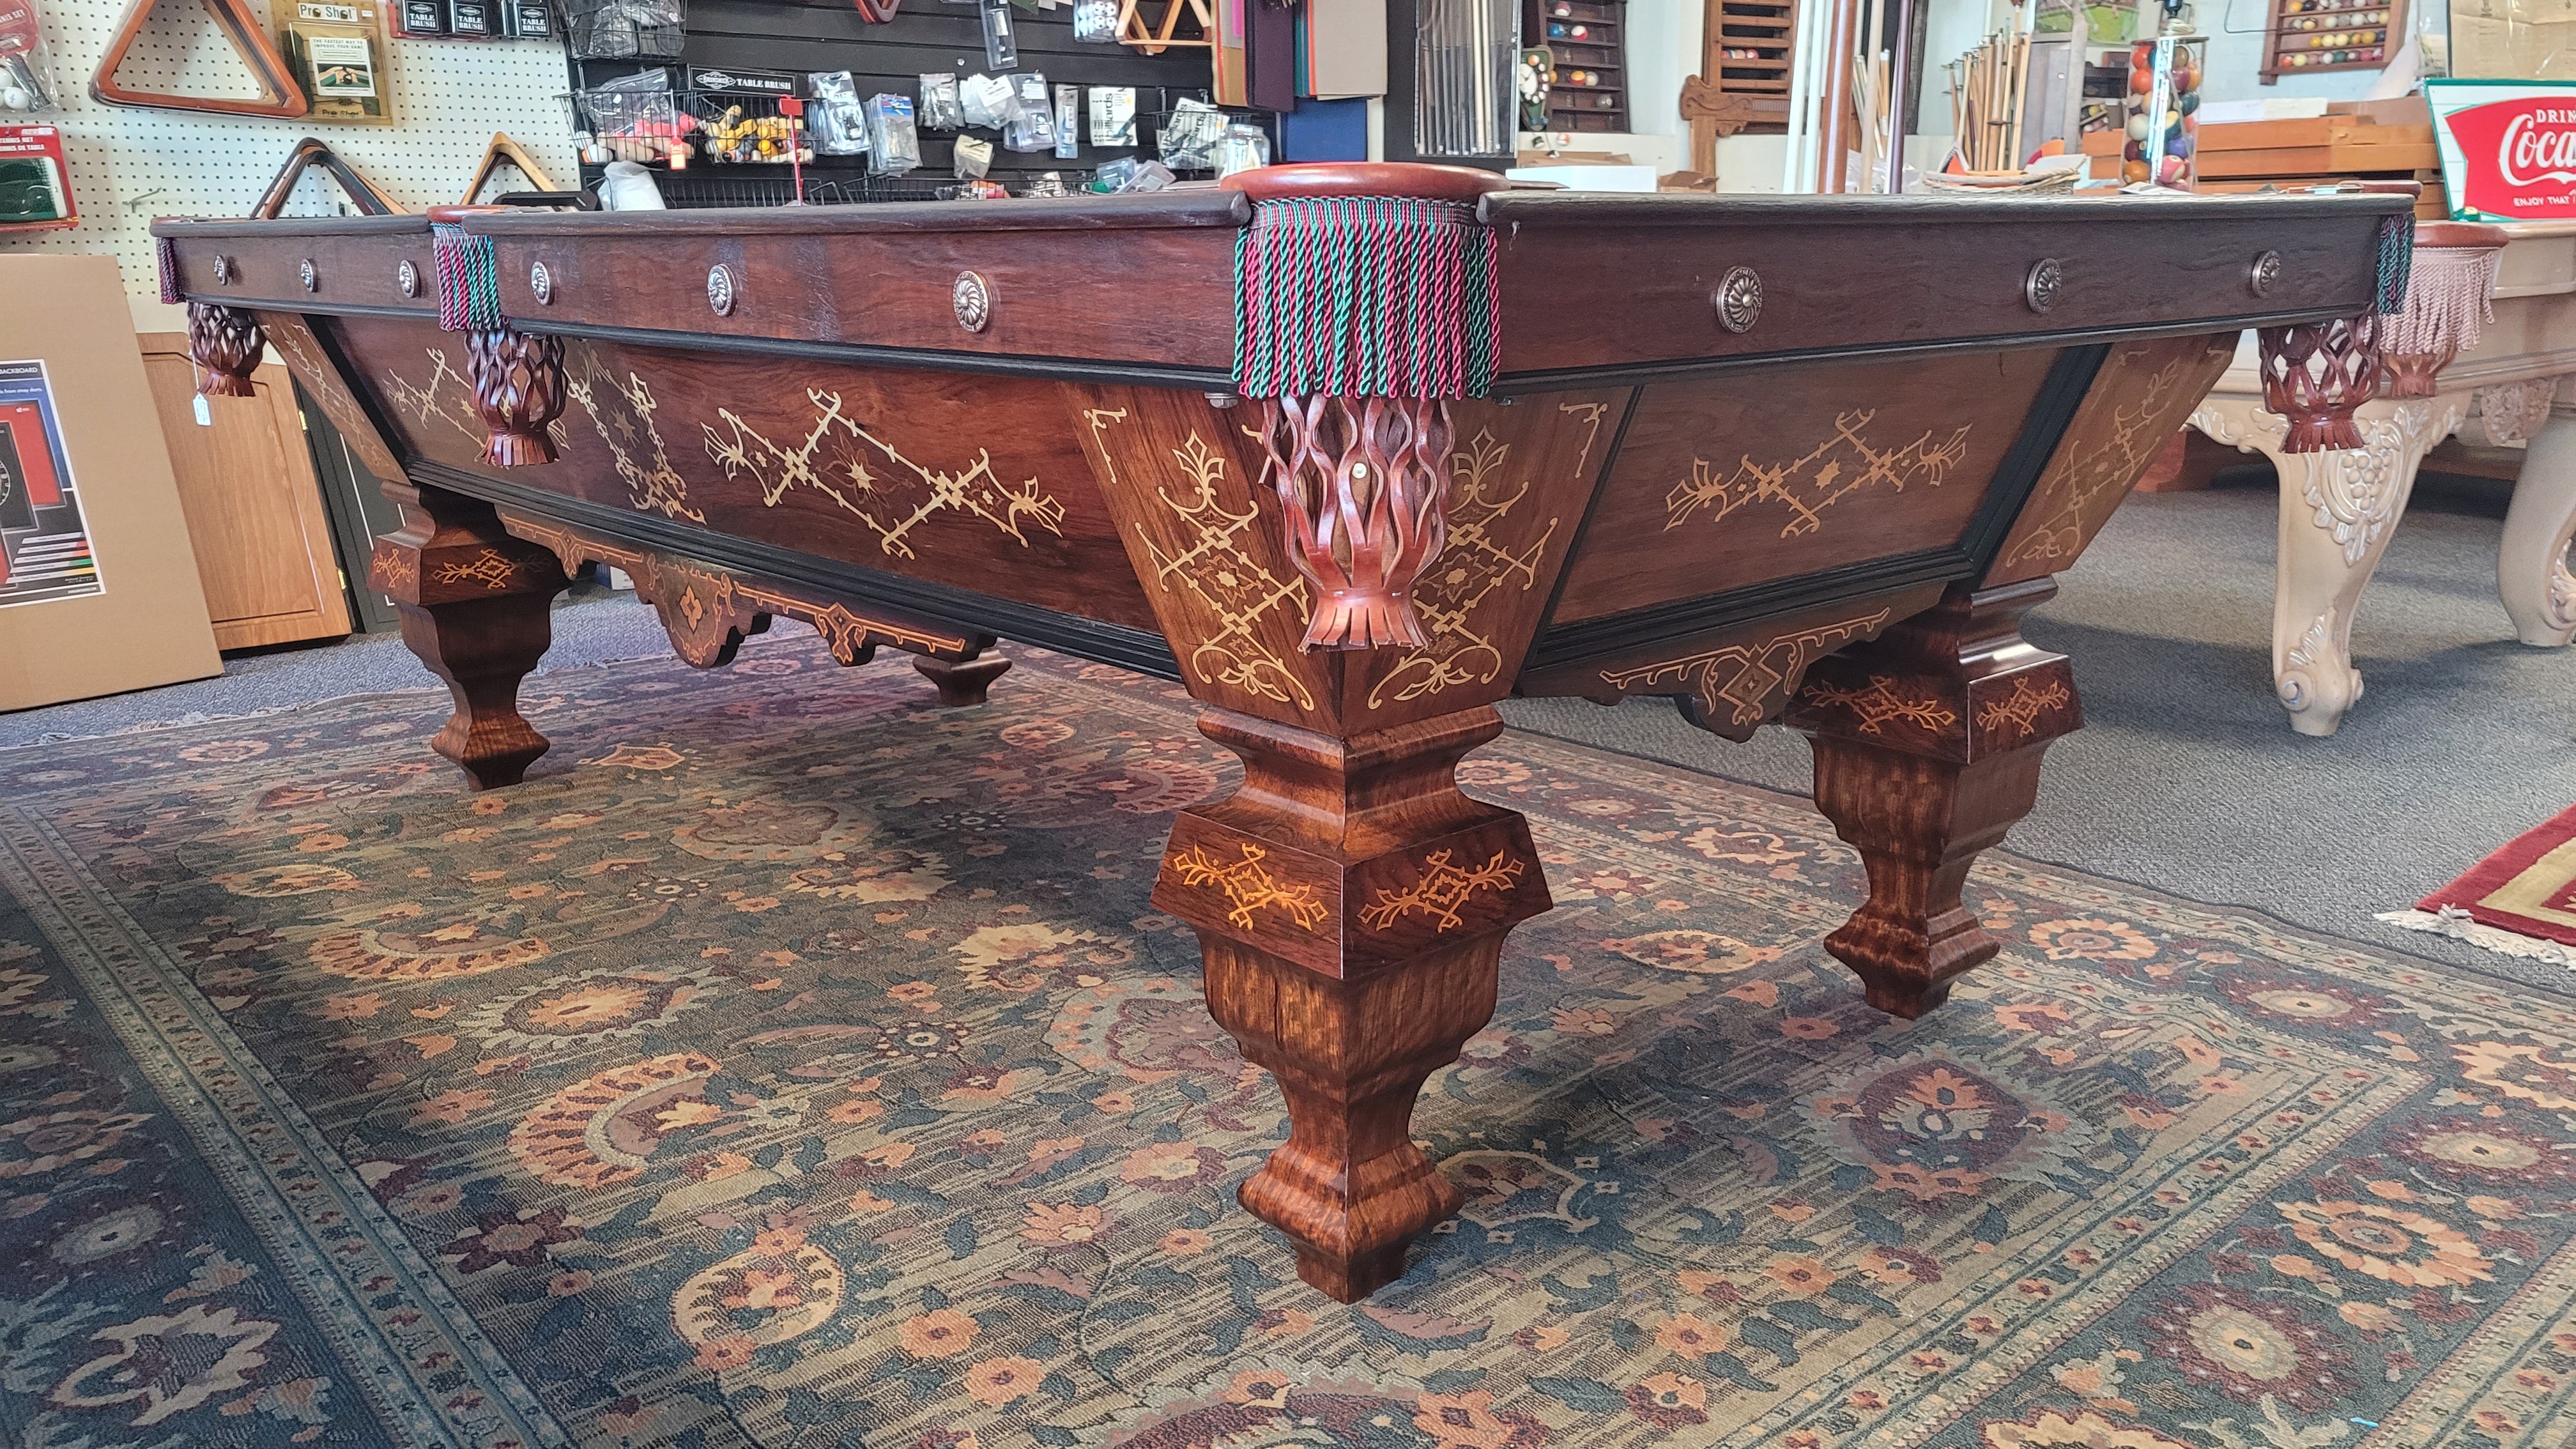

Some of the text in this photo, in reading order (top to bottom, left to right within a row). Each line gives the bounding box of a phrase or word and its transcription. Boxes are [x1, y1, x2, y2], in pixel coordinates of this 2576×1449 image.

[12, 9, 26, 19] SET
[300, 4, 353, 19] Pro Shot
[736, 78, 763, 88] TABLE
[764, 81, 792, 90] BRUSH
[2513, 197, 2544, 207] ENJOY
[2547, 195, 2570, 204] THAT
